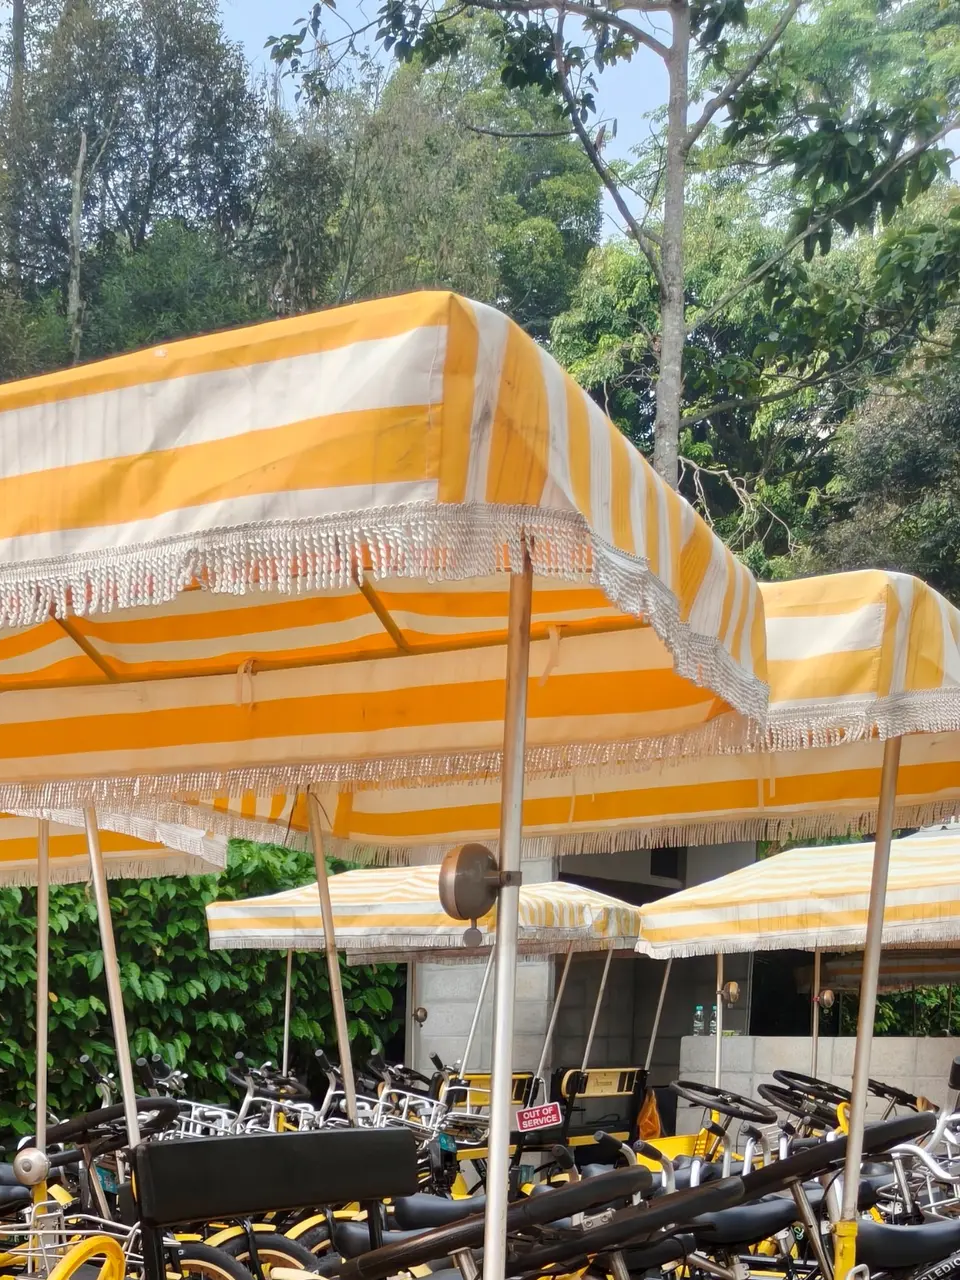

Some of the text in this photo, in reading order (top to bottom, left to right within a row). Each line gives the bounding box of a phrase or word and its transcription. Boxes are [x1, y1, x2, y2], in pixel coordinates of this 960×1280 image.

[523, 1106, 554, 1119] OUT OF
[522, 1114, 558, 1128] SERVICE
